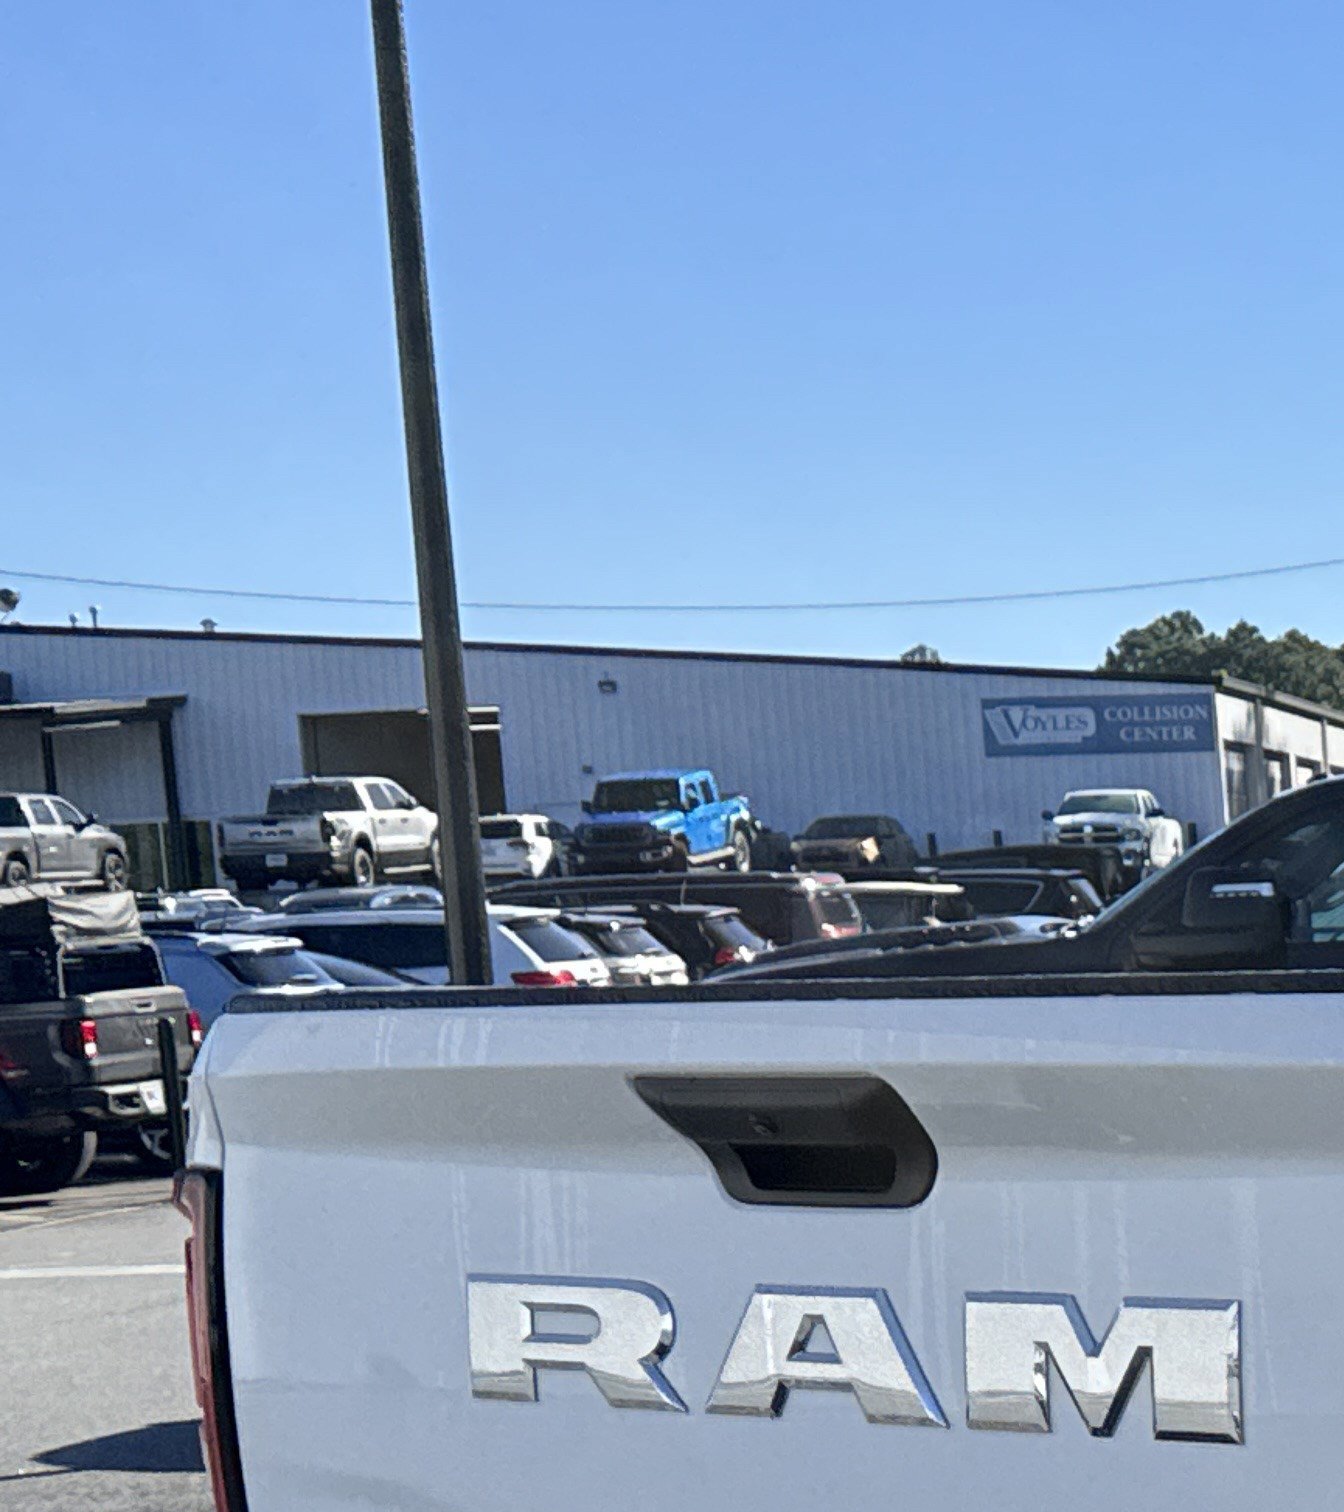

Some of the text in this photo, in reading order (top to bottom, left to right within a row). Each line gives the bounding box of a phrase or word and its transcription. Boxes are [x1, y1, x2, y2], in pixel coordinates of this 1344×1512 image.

[1001, 707, 1089, 739] VOYLES
[1104, 703, 1209, 721] COLLISION
[1119, 724, 1196, 742] CENTER
[466, 1272, 1245, 1446] RAM
